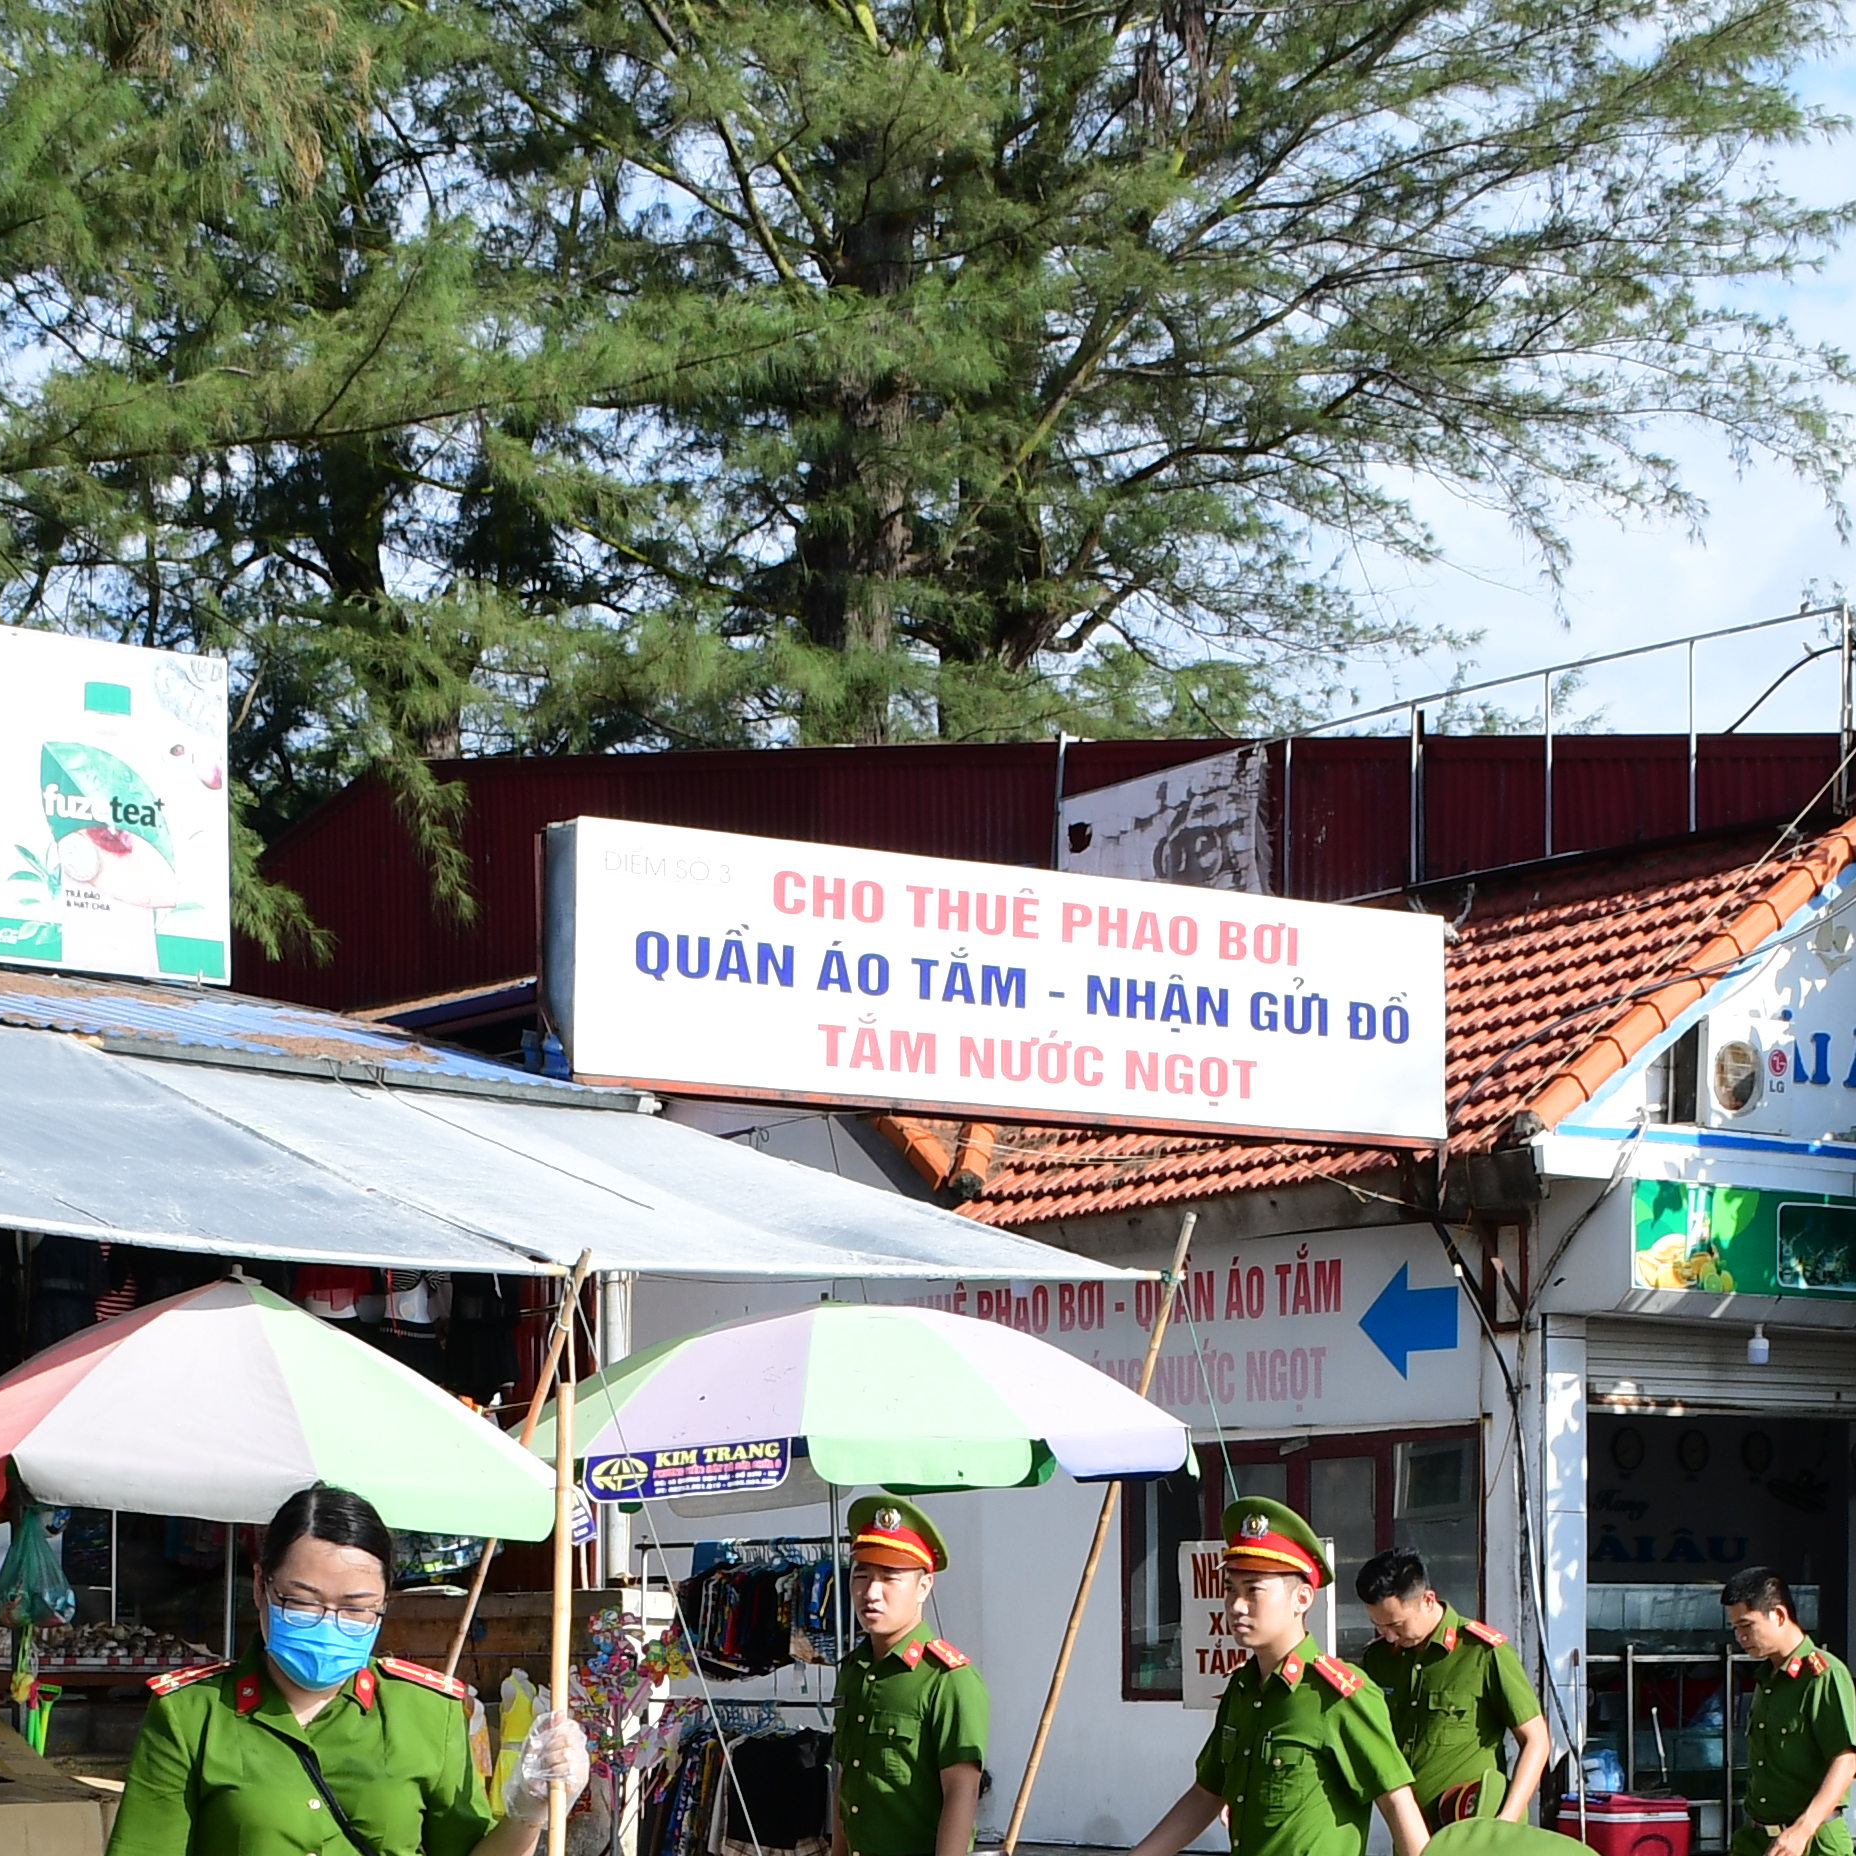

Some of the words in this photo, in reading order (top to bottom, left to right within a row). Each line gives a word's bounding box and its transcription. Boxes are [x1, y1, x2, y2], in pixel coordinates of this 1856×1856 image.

[718, 864, 732, 885] 3
[772, 870, 885, 925] CHO
[905, 881, 1039, 941] THUÊ
[1061, 900, 1199, 957] PHAO
[1219, 918, 1300, 967] BƠI
[635, 923, 795, 990] QUẦN
[816, 946, 891, 996] ÁO
[910, 946, 1029, 1010] TẮM
[1085, 974, 1230, 1036] NHẬN
[1249, 980, 1329, 1034] GỬI
[1347, 992, 1410, 1045] ĐỒ
[817, 1012, 938, 1076] TẮM
[958, 1033, 1105, 1087] NƯỚC
[1124, 1050, 1259, 1109] NGỌT
[1769, 1080, 1785, 1094] LG
[1225, 1255, 1265, 1321] ÁO
[1275, 1242, 1342, 1316] TẮM
[1246, 1346, 1327, 1413] NGỌT
[655, 1449, 698, 1468] KIM
[703, 1442, 781, 1463] TRANG
